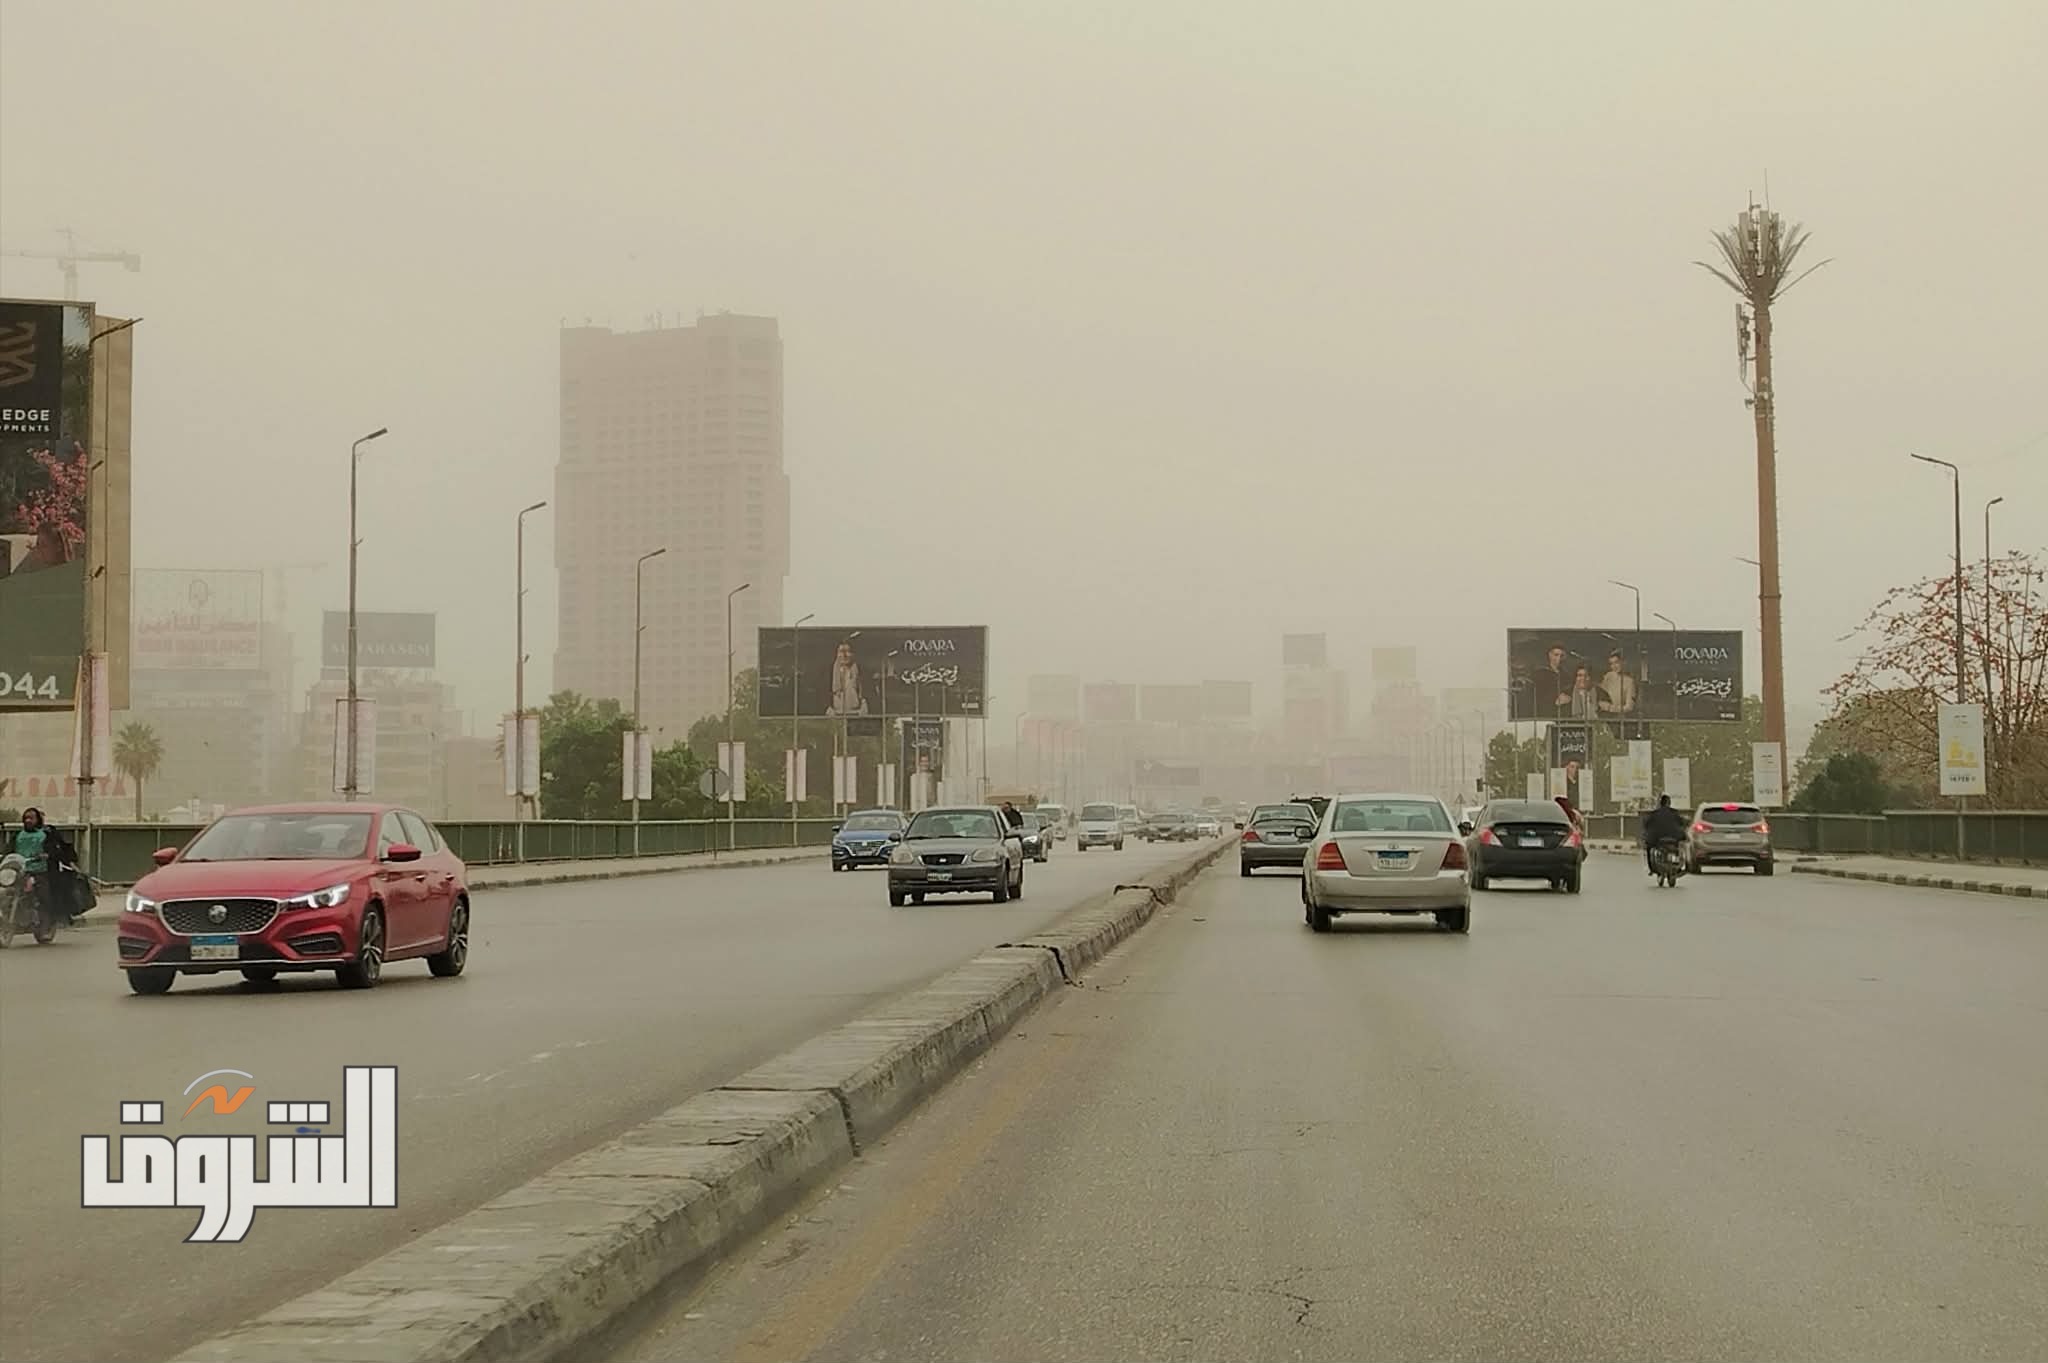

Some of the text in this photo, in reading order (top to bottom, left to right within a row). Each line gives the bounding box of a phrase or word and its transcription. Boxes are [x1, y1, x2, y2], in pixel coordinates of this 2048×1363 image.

[2, 409, 50, 421] EDGE
[0, 424, 50, 433] PMENTS
[904, 639, 955, 651] NOVARA
[1674, 647, 1728, 660] NOVARA
